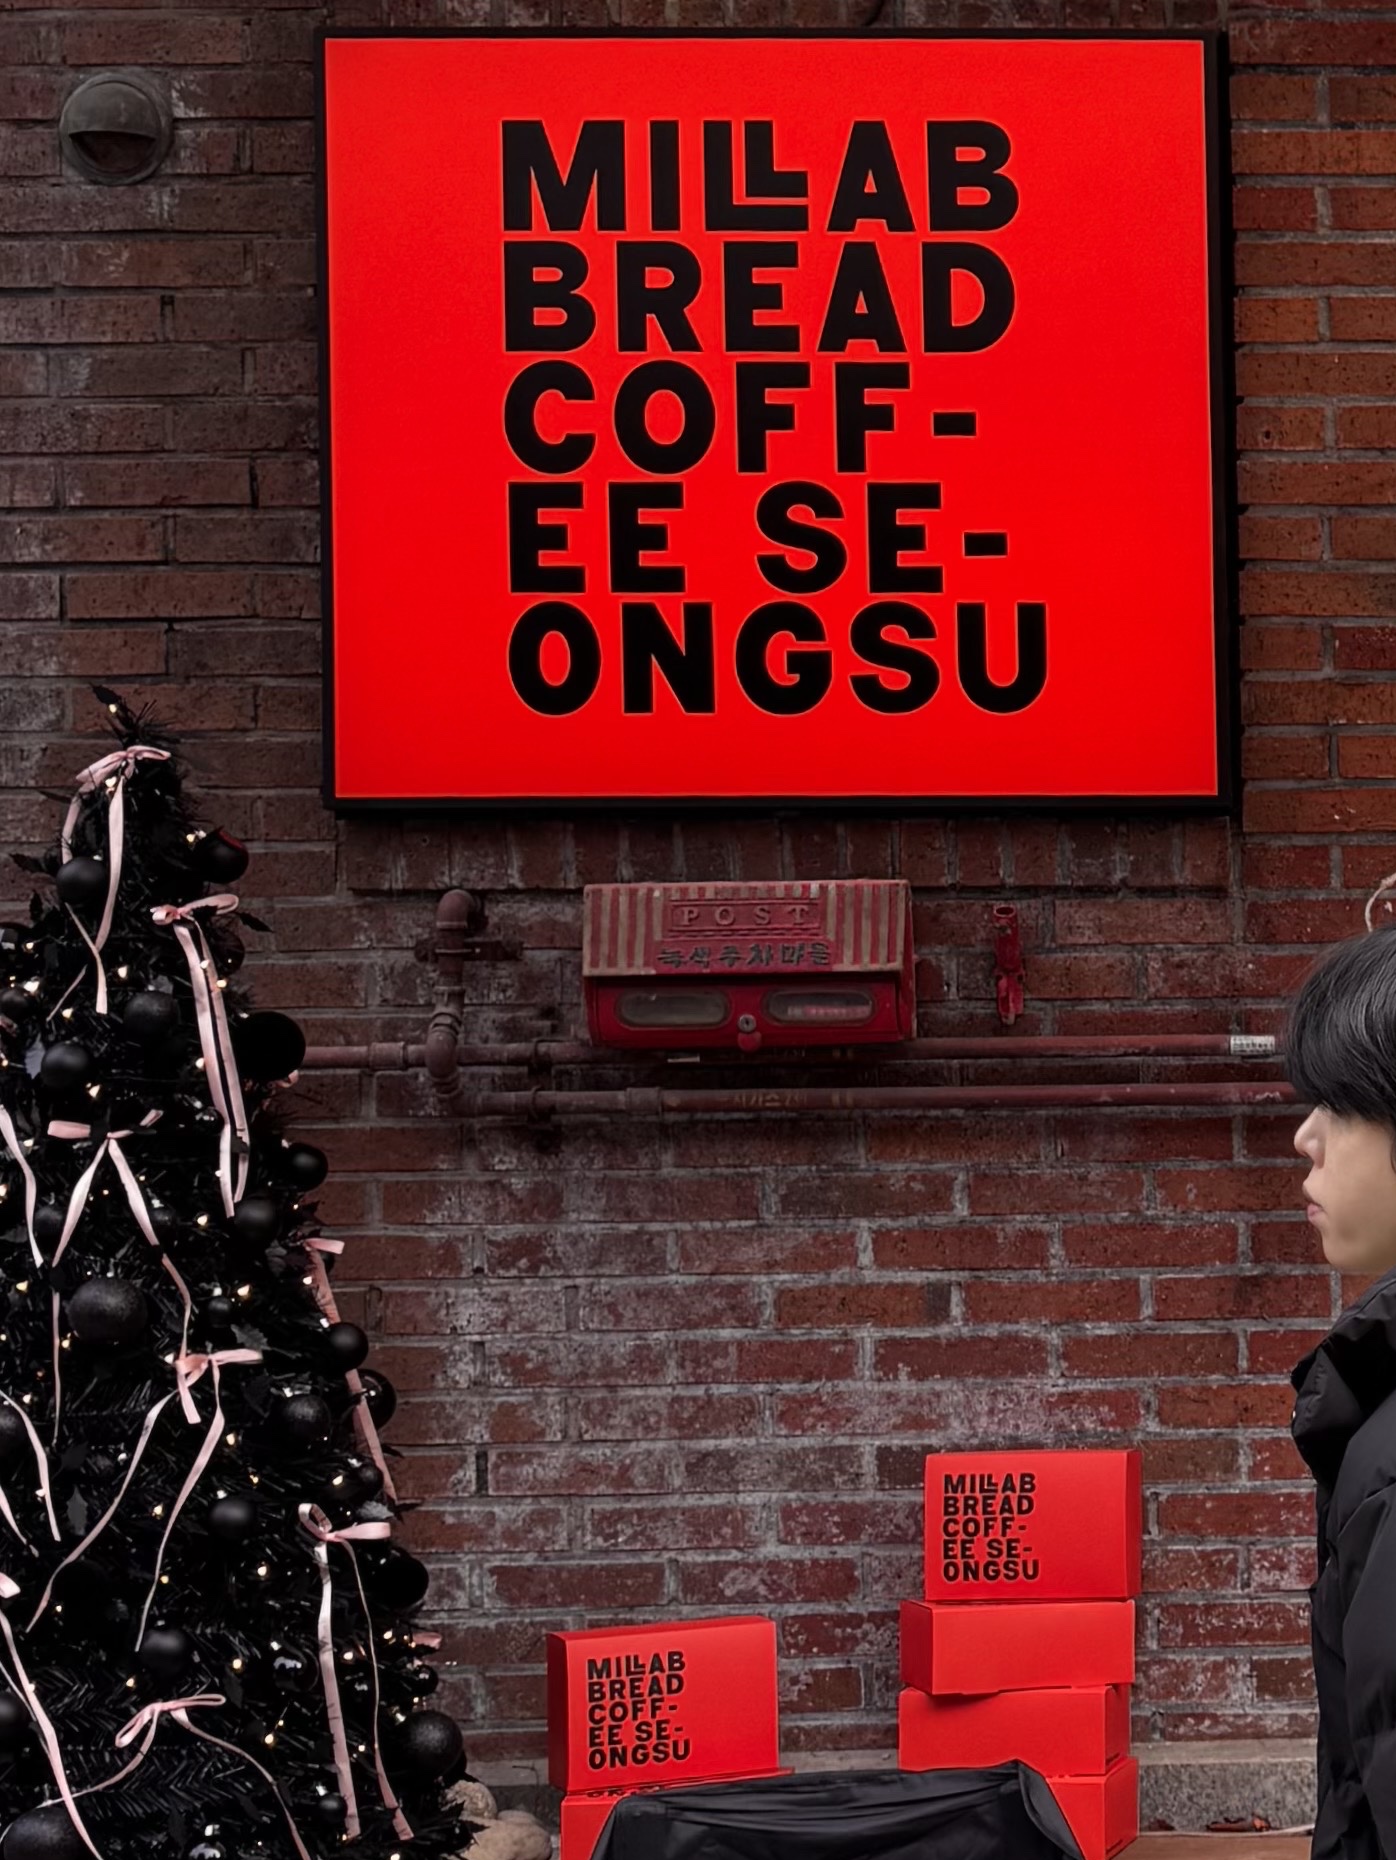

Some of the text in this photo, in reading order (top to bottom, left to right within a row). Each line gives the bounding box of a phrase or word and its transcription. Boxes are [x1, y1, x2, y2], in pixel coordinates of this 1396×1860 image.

[501, 119, 1019, 233] MILLAB
[503, 240, 1016, 353] BREAD
[504, 360, 977, 475] COFF-
[508, 480, 1008, 595] EE SE-
[508, 601, 1047, 716] ONGSU
[680, 906, 809, 926] POST
[943, 1473, 1036, 1494] MILLAB
[943, 1495, 1034, 1516] BREAD
[943, 1517, 1027, 1538] COFF-
[943, 1538, 1032, 1560] EE SE-
[943, 1559, 1039, 1582] ONGSU
[587, 1651, 686, 1680] MILLAB
[588, 1674, 684, 1703] BREAD
[588, 1697, 678, 1725] COFF-
[589, 1719, 684, 1748] EE SE-
[588, 1739, 690, 1770] ONGSU
